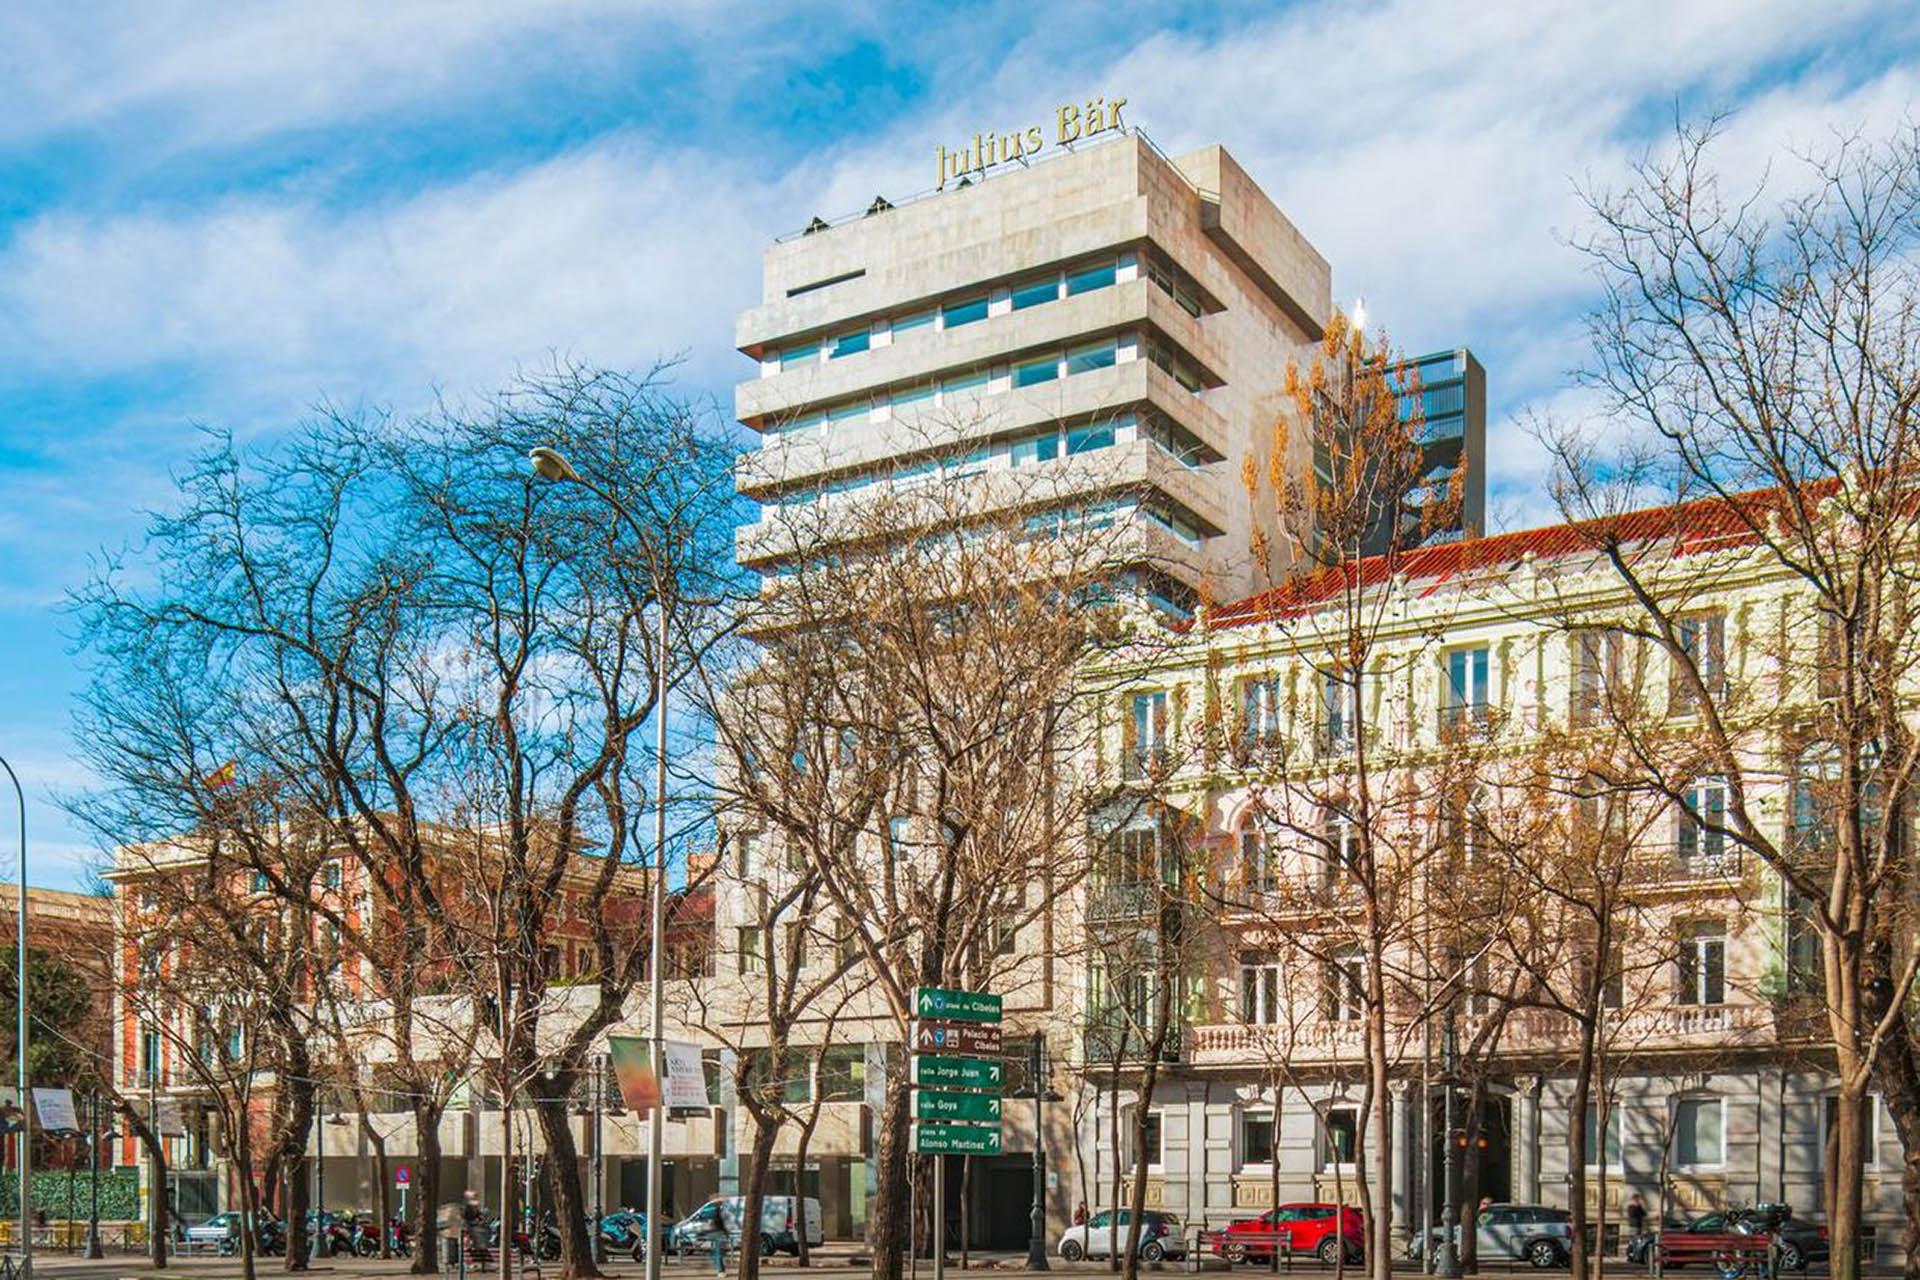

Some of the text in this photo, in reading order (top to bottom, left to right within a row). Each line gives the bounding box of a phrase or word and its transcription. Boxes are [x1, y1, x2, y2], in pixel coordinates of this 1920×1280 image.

[936, 97, 1127, 192] Julius Bär
[972, 1002, 1000, 1013] Cibeles
[962, 1028, 1000, 1041] Palacio de
[974, 1041, 1000, 1051] Cibeles
[937, 1065, 958, 1079] Jorge
[961, 1066, 980, 1077] Juan
[937, 1099, 958, 1112] Goya
[920, 1138, 948, 1149] Alonso
